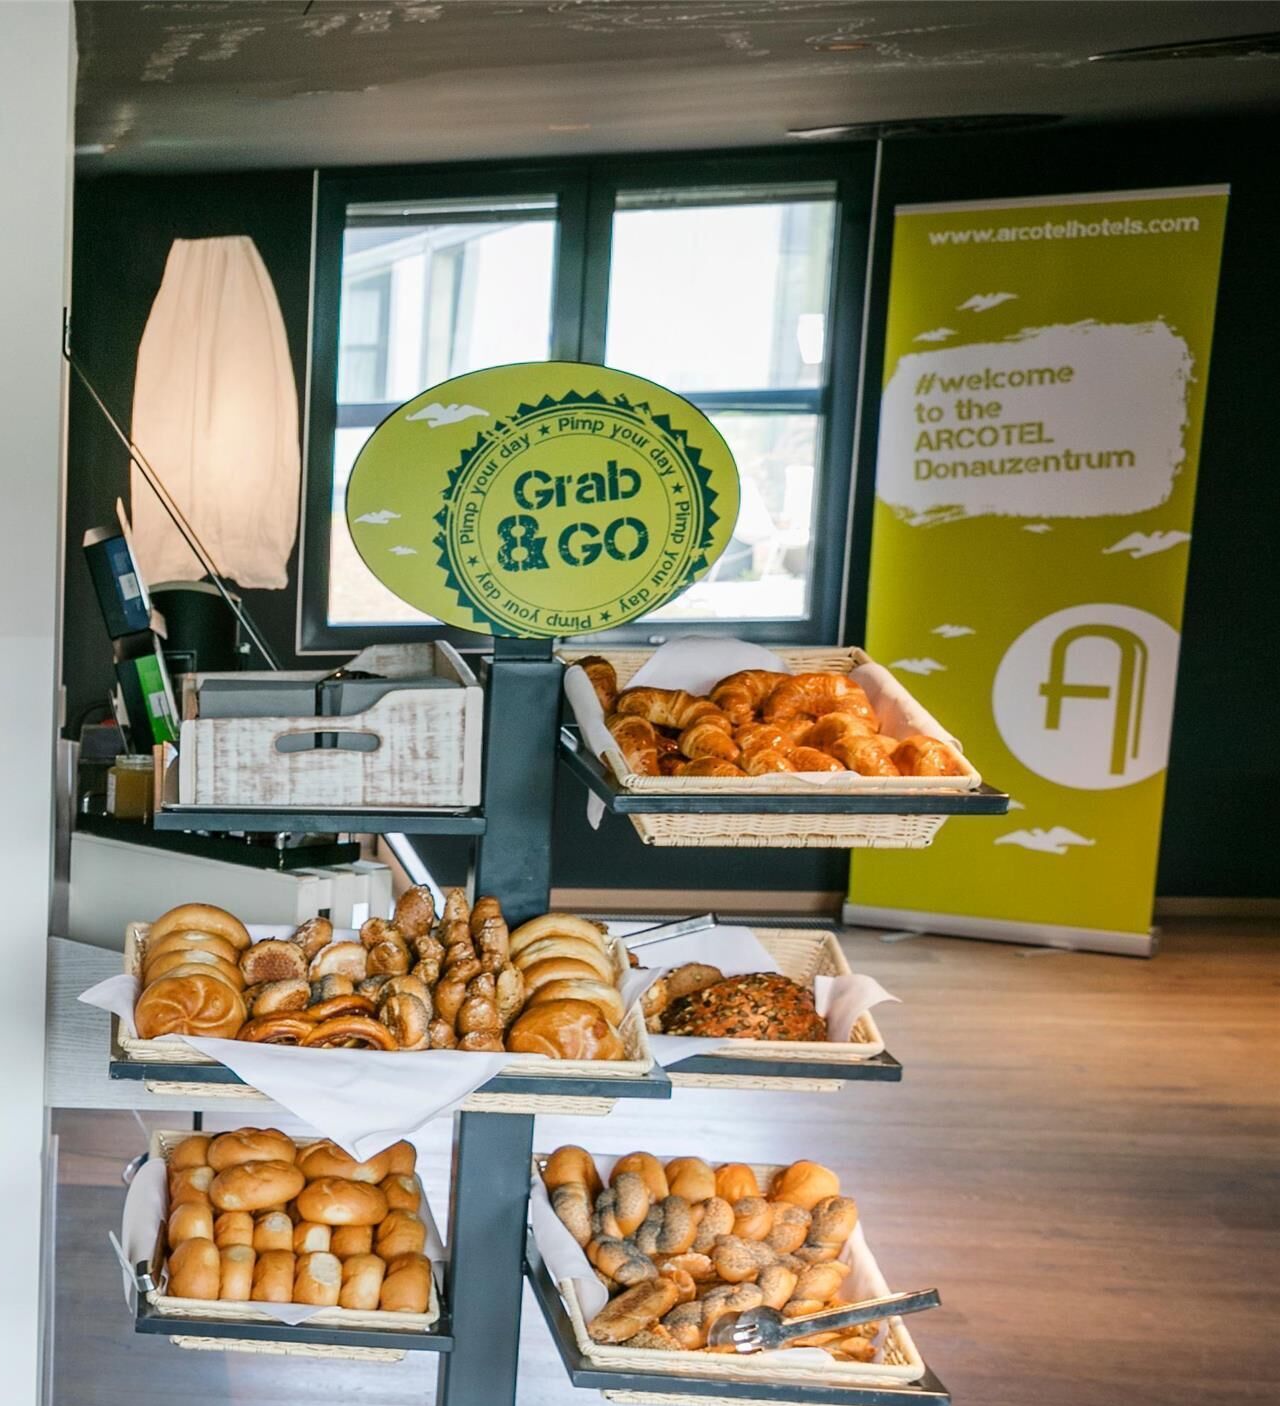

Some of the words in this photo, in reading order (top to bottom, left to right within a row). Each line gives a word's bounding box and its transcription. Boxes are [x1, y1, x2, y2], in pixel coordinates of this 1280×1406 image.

[928, 215, 1200, 246] www.arcotelhotels.com
[914, 363, 1075, 396] #welcome
[914, 402, 943, 425] to
[954, 397, 1002, 421] the
[557, 416, 605, 433] Pimp
[609, 421, 651, 450] your
[648, 446, 677, 479] day
[914, 421, 1054, 453] ARCOTEL
[914, 448, 1136, 482] Donauzentrum
[459, 501, 480, 546] Pimp
[470, 459, 500, 498] your
[498, 431, 531, 460] day
[513, 458, 643, 511] Grab
[669, 499, 691, 546] Pimp
[496, 513, 550, 573] &
[557, 515, 650, 567] GO
[650, 549, 680, 587] your
[475, 570, 502, 601] day
[617, 587, 651, 614] day
[501, 599, 540, 627] your
[545, 613, 592, 631] Pimp
